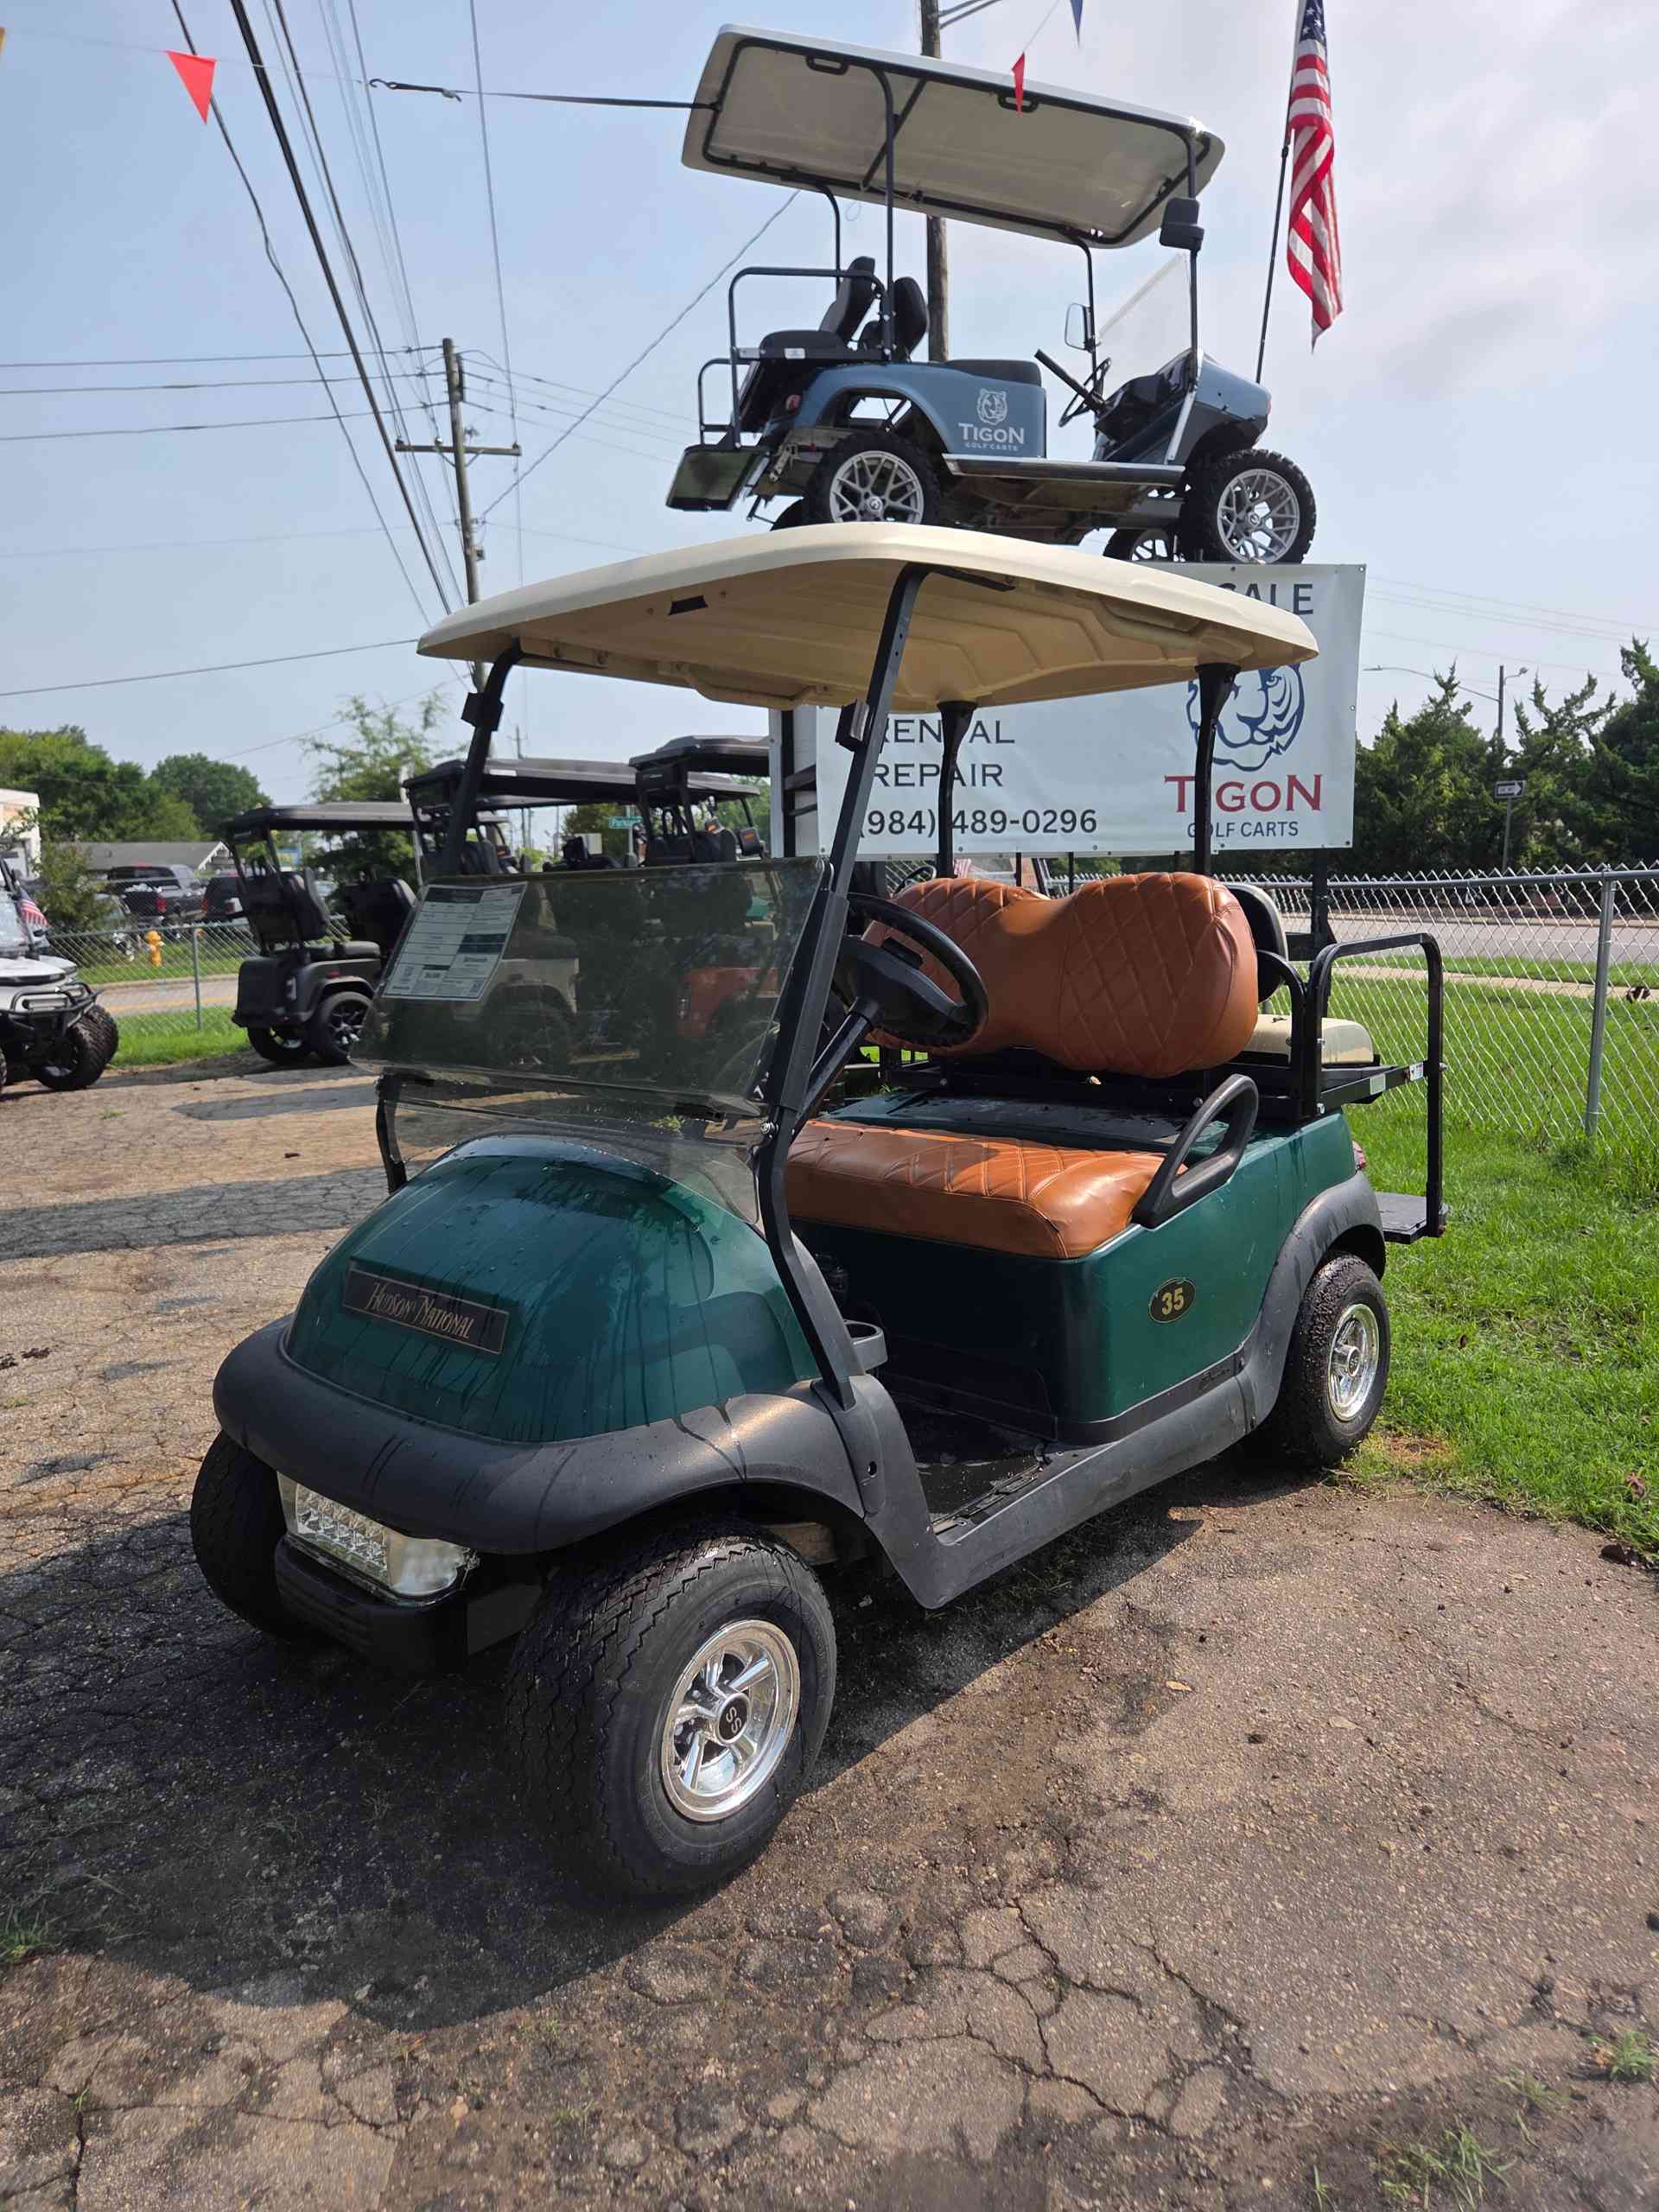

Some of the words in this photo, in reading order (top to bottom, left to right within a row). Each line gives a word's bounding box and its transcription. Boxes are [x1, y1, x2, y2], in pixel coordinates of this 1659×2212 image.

[958, 423, 1025, 444] TIGON
[964, 442, 988, 450] GOLF
[989, 443, 1019, 452] CARTS
[1217, 582, 1314, 615] ALE
[884, 719, 1015, 744] ENAL
[1165, 774, 1322, 812] TGON
[860, 809, 936, 837] 984)
[951, 809, 1097, 835] 489-0296
[1187, 822, 1235, 837] GLF
[1241, 821, 1299, 837] CARTS
[1161, 1287, 1185, 1315] 35
